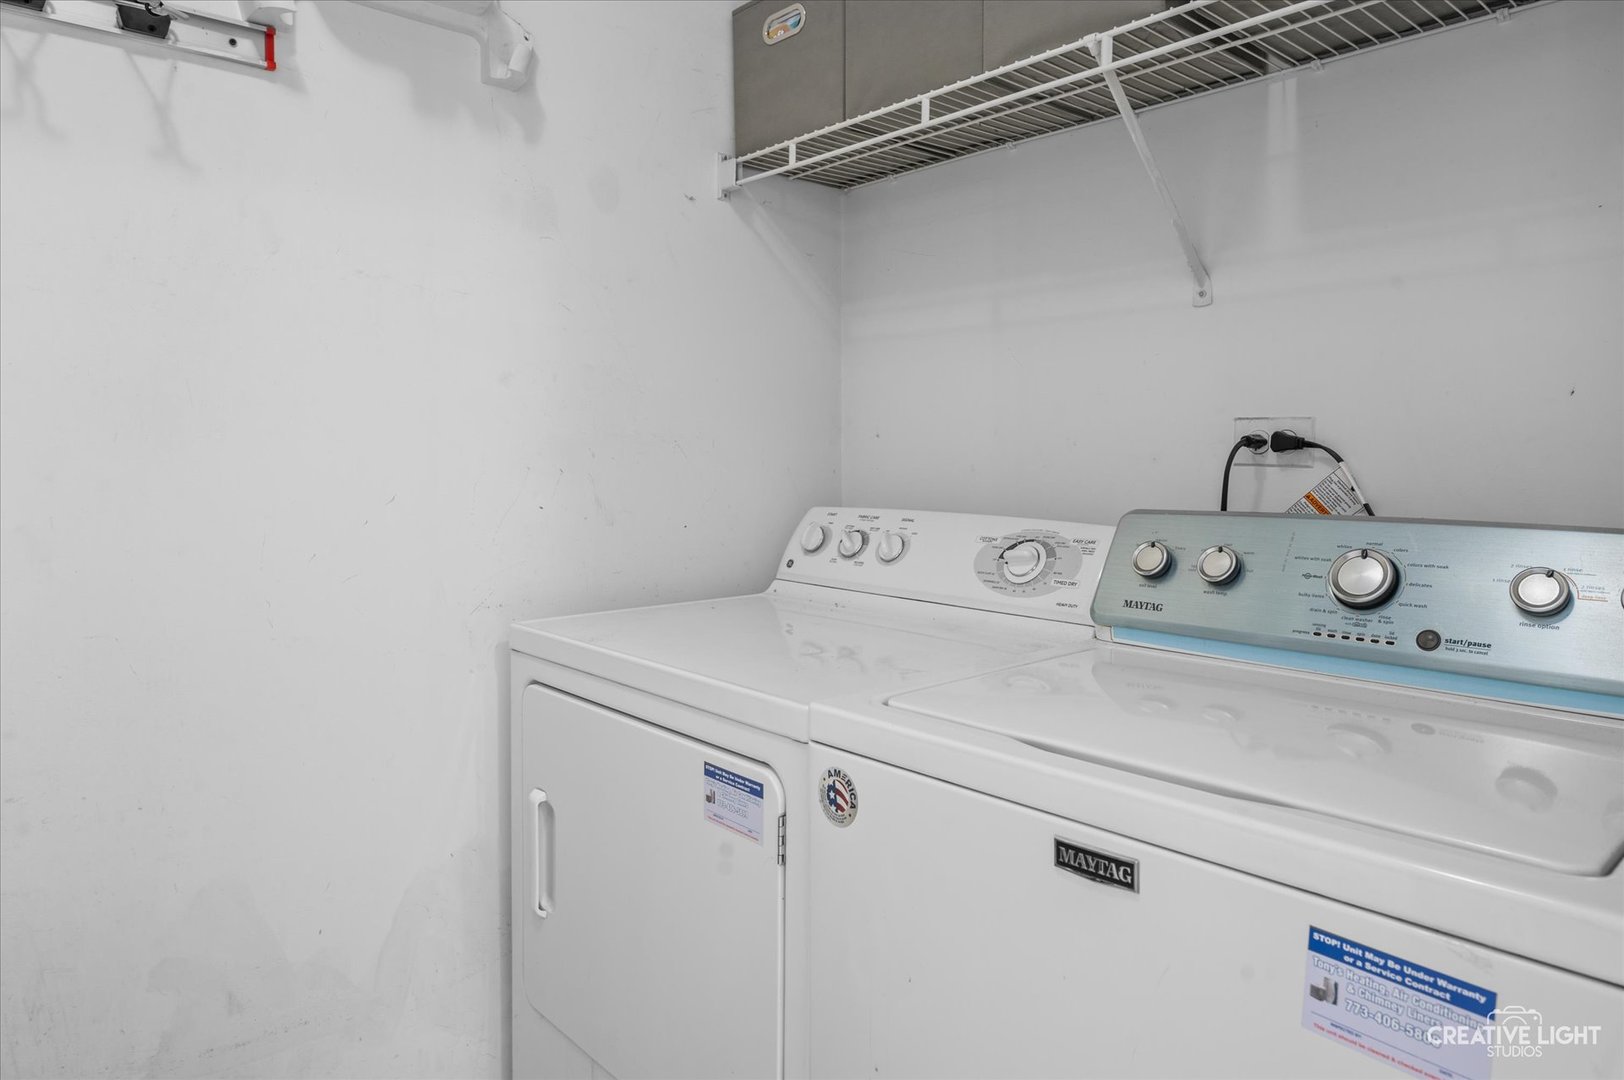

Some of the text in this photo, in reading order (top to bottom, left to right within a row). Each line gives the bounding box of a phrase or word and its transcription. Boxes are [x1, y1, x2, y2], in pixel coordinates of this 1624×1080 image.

[1123, 599, 1163, 612] MAYTAG
[1444, 638, 1492, 648] start/pause
[1537, 623, 1560, 631] option
[827, 769, 857, 809] AMERICA
[1058, 845, 1132, 884] MAYTAG
[1312, 931, 1487, 1004] STOP! Unit May Be Under Warranty
[1313, 955, 1344, 977] Tony's
[1345, 968, 1389, 995] Heating,
[1391, 986, 1409, 1001] Air
[1343, 955, 1354, 964] or
[1364, 962, 1403, 982] Service
[1404, 977, 1451, 1001] Contract
[1346, 982, 1356, 994] &
[1358, 987, 1404, 1016] Chimney
